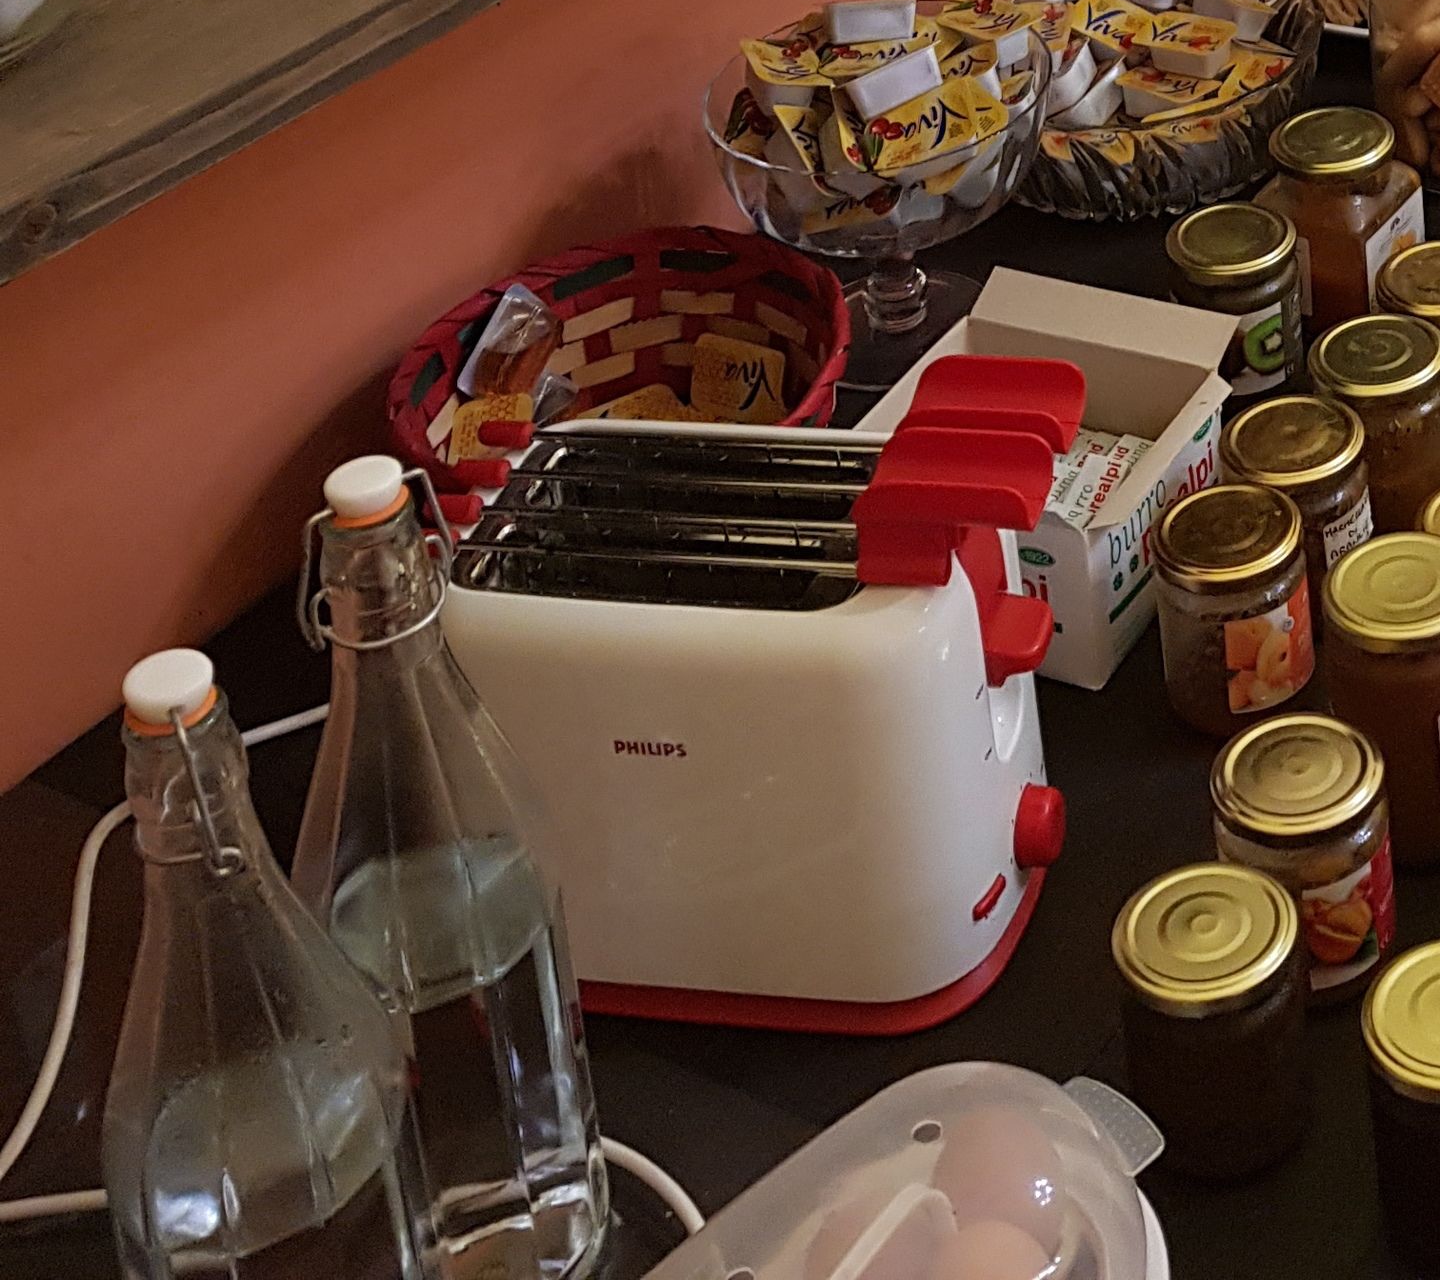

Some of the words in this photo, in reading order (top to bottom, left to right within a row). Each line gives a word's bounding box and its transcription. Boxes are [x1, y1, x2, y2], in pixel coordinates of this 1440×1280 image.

[1086, 1, 1132, 42] Viva
[901, 97, 969, 150] Viva
[725, 357, 777, 411] Viva
[1108, 479, 1166, 568] burro
[613, 739, 688, 757] PHILIPS
